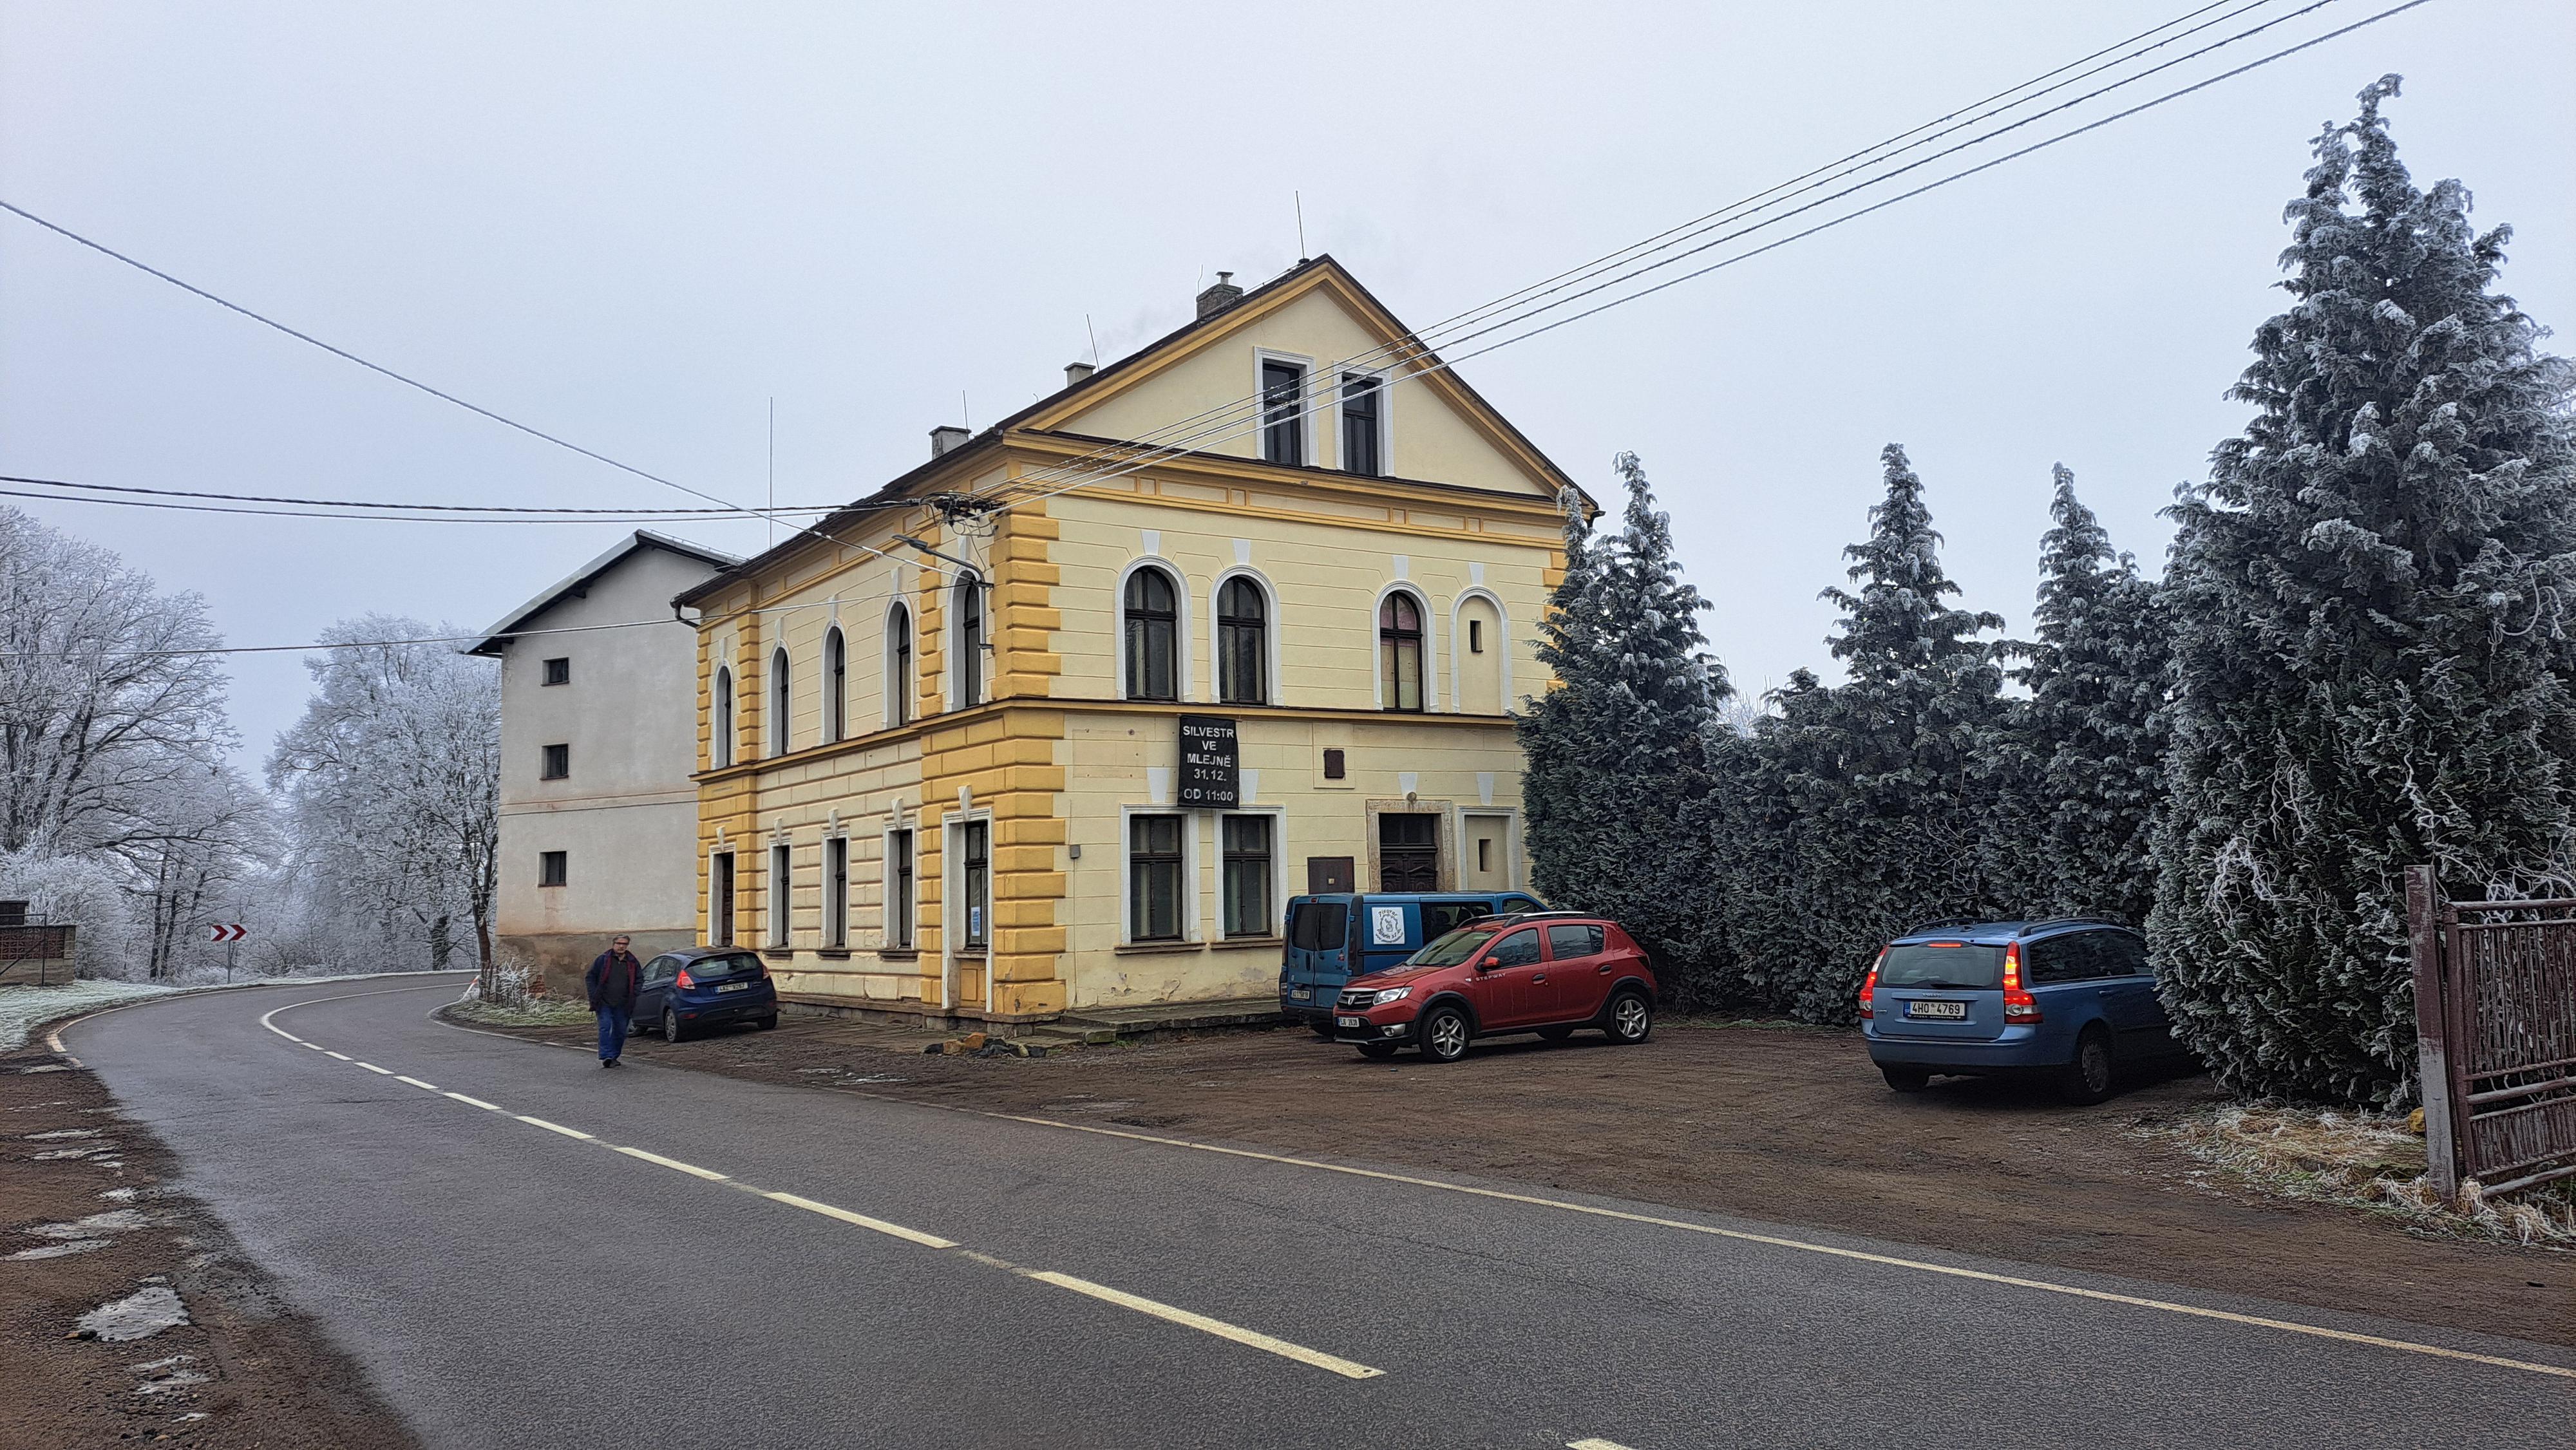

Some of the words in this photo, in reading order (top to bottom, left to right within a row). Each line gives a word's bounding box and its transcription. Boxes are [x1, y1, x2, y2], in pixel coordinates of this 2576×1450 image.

[1182, 726, 1235, 739] SILVESTR
[1202, 740, 1217, 751] VE
[1187, 753, 1231, 767] MLEJNĚ
[1184, 788, 1202, 800] OD
[1206, 789, 1233, 802] 11:00
[1475, 972, 1506, 981] STEPWAY
[1937, 1004, 1960, 1015] 4769
